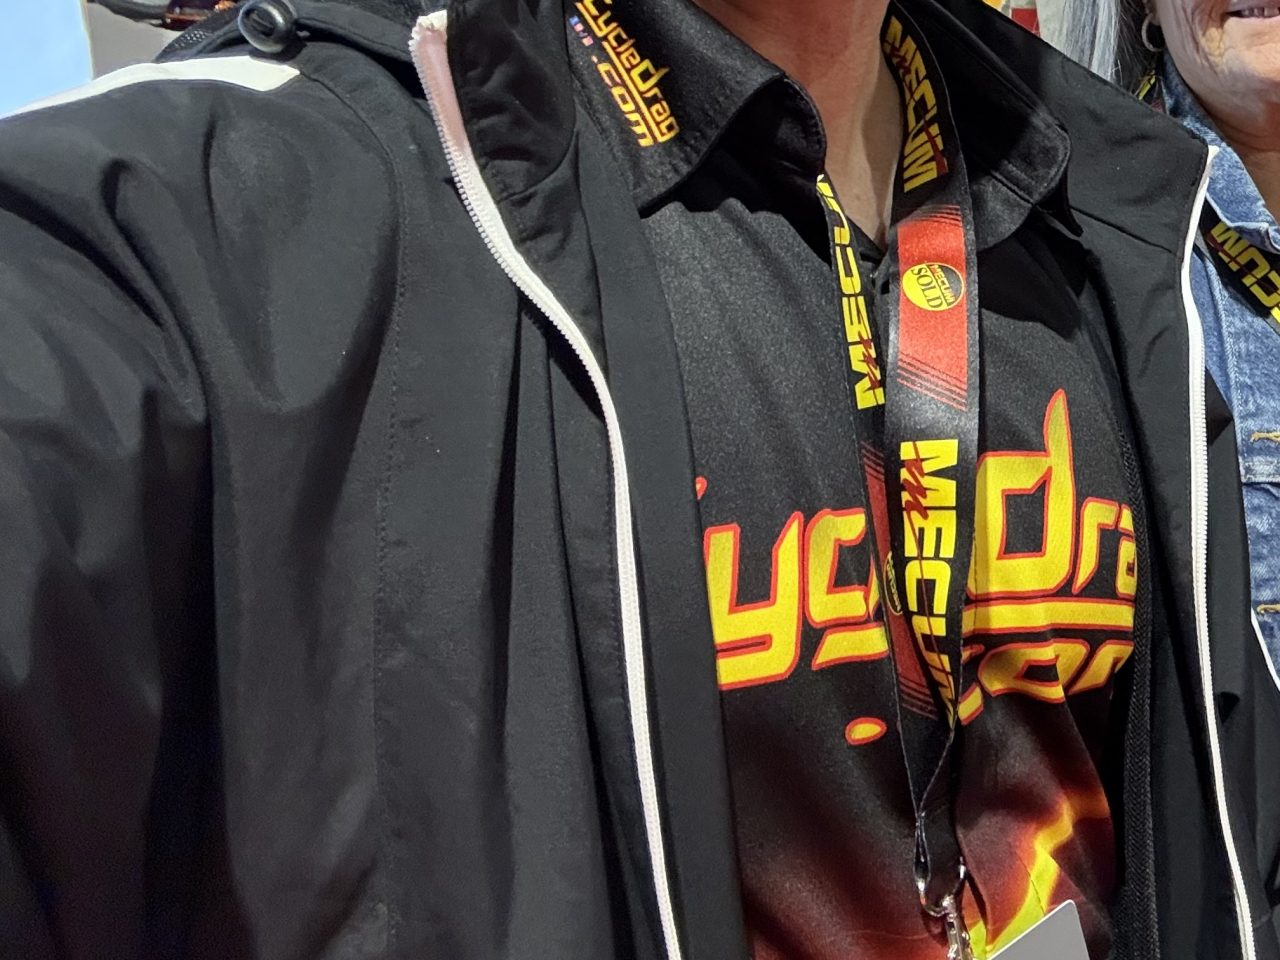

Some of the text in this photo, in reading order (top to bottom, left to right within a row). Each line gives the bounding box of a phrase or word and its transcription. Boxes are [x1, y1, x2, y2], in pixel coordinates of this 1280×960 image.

[591, 55, 654, 147] .com
[882, 15, 948, 193] MECUM
[911, 267, 943, 308] SOLD
